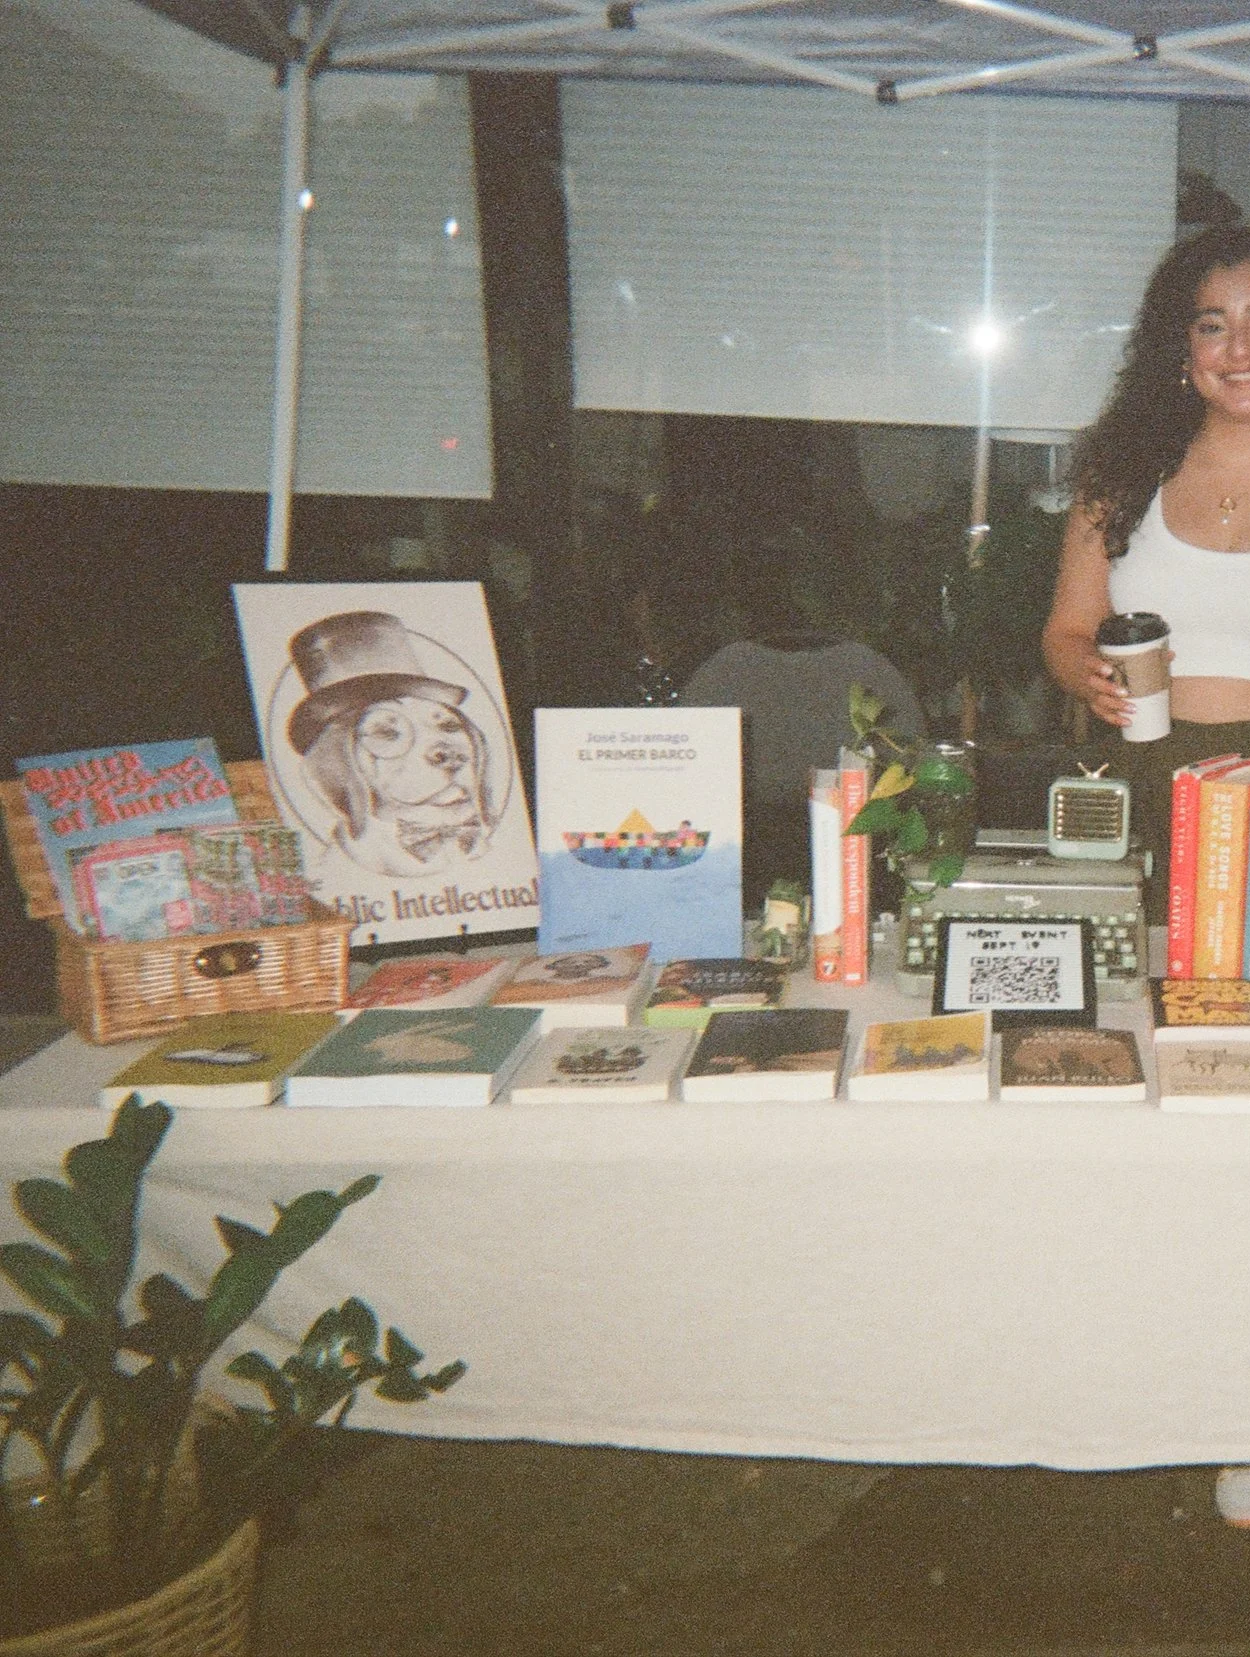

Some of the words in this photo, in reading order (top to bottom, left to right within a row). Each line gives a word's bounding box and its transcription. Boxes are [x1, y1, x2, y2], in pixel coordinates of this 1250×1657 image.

[577, 748, 594, 761] EL
[595, 748, 646, 761] PRIMER
[648, 748, 697, 761] BARCO
[620, 731, 690, 747] Saramago
[1219, 804, 1234, 840] LOVE
[845, 810, 863, 914] respondent
[1217, 846, 1231, 891] SONGS
[391, 877, 539, 921] Intellectual
